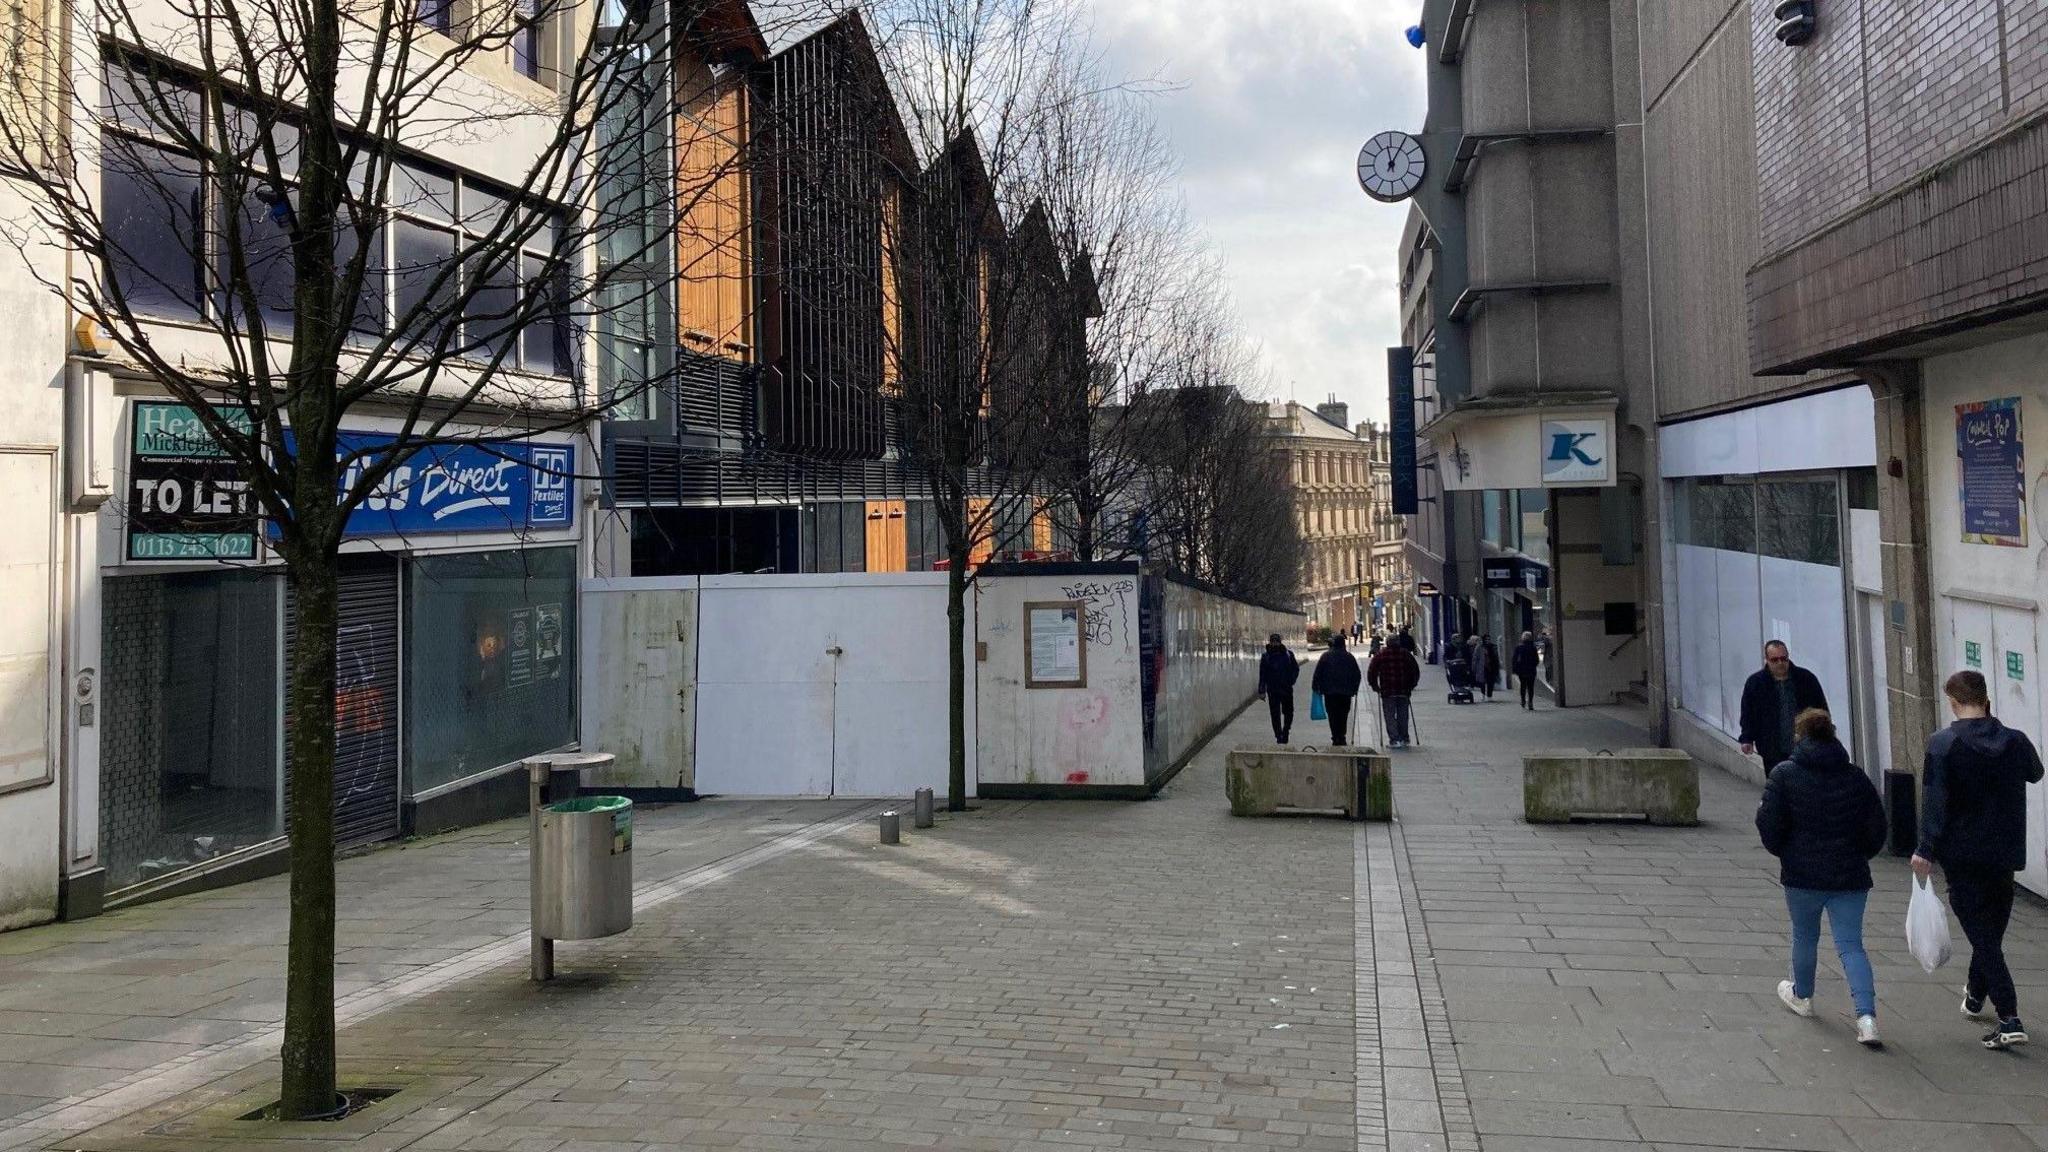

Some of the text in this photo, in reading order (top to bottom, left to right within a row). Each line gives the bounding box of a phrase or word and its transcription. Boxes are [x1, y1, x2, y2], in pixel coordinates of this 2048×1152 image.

[143, 406, 251, 438] Hea
[1547, 432, 1602, 466] K
[136, 479, 249, 513] TO LET
[420, 453, 517, 506] Direct
[533, 490, 564, 501] Textiles
[136, 537, 248, 556] 0113 245 1622
